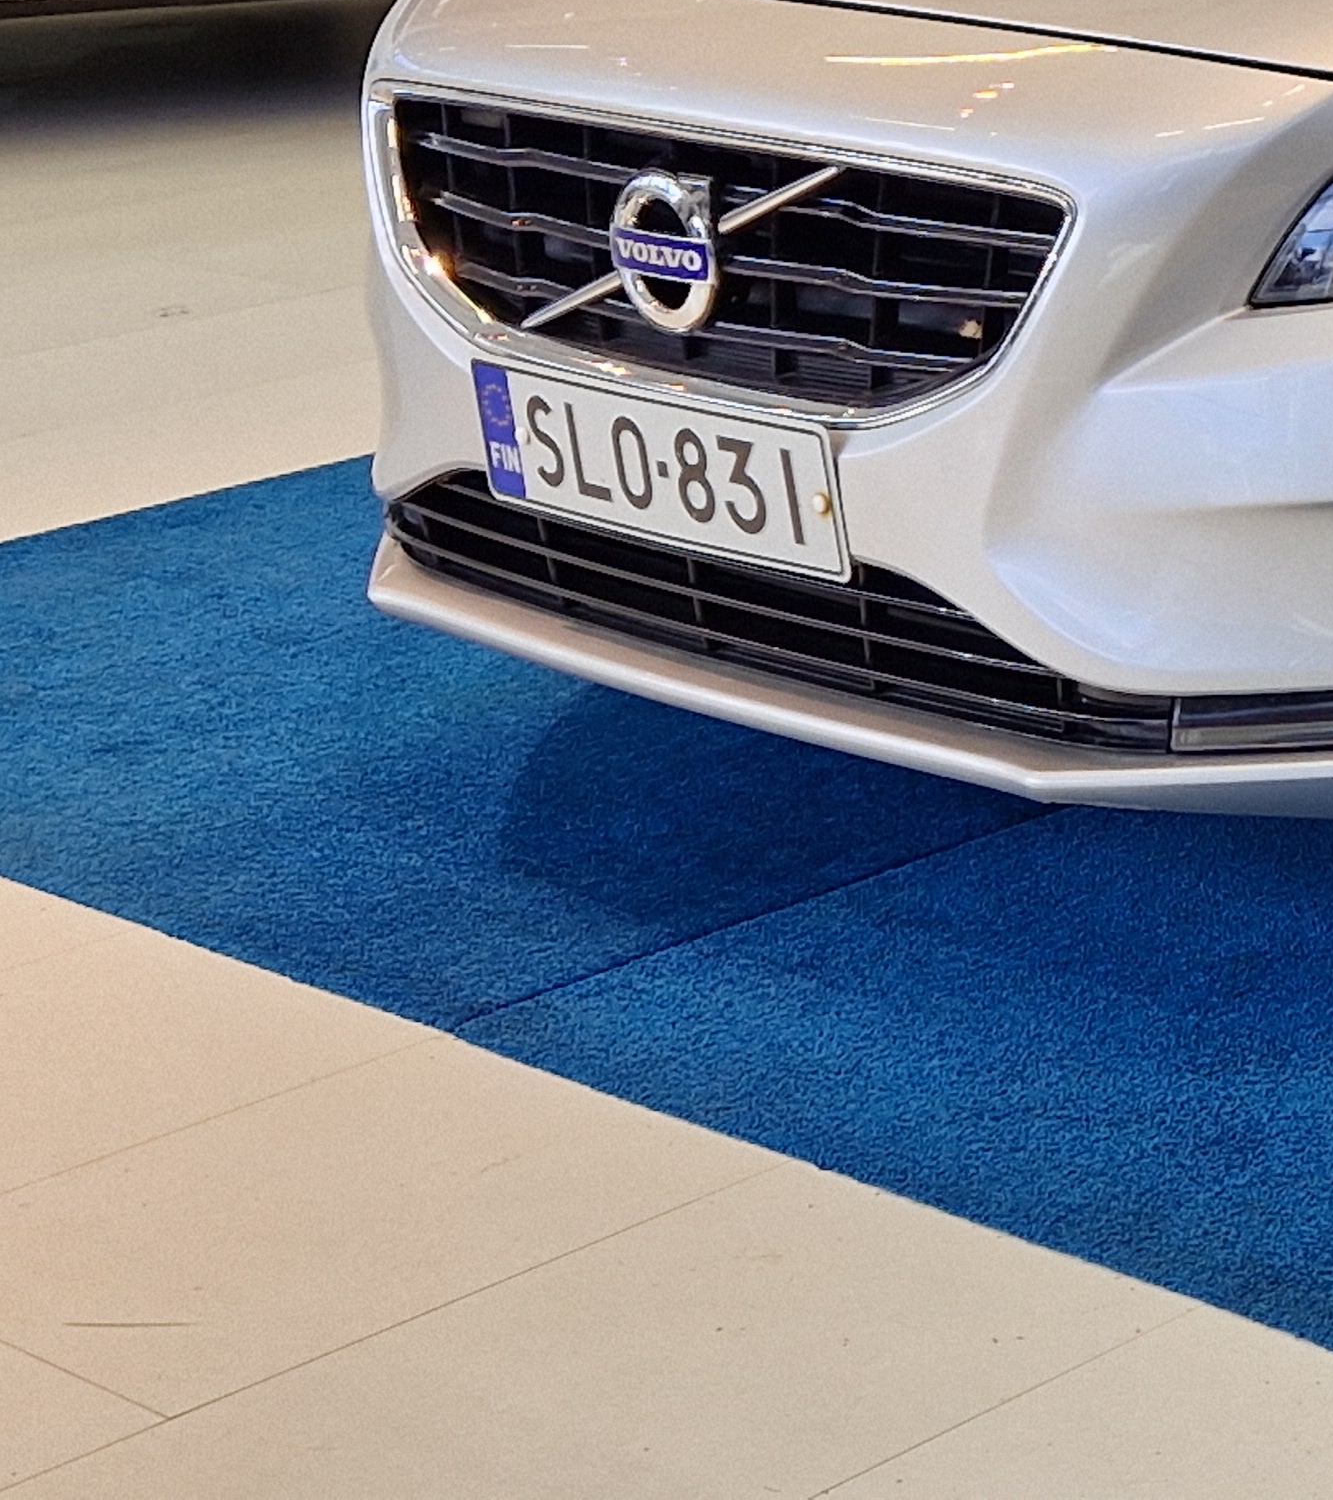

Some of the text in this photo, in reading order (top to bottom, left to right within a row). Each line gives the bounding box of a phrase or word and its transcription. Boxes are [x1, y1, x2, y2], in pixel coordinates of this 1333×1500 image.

[615, 237, 702, 271] VOLVO
[489, 441, 521, 474] FIN
[526, 395, 805, 545] SLO-831
